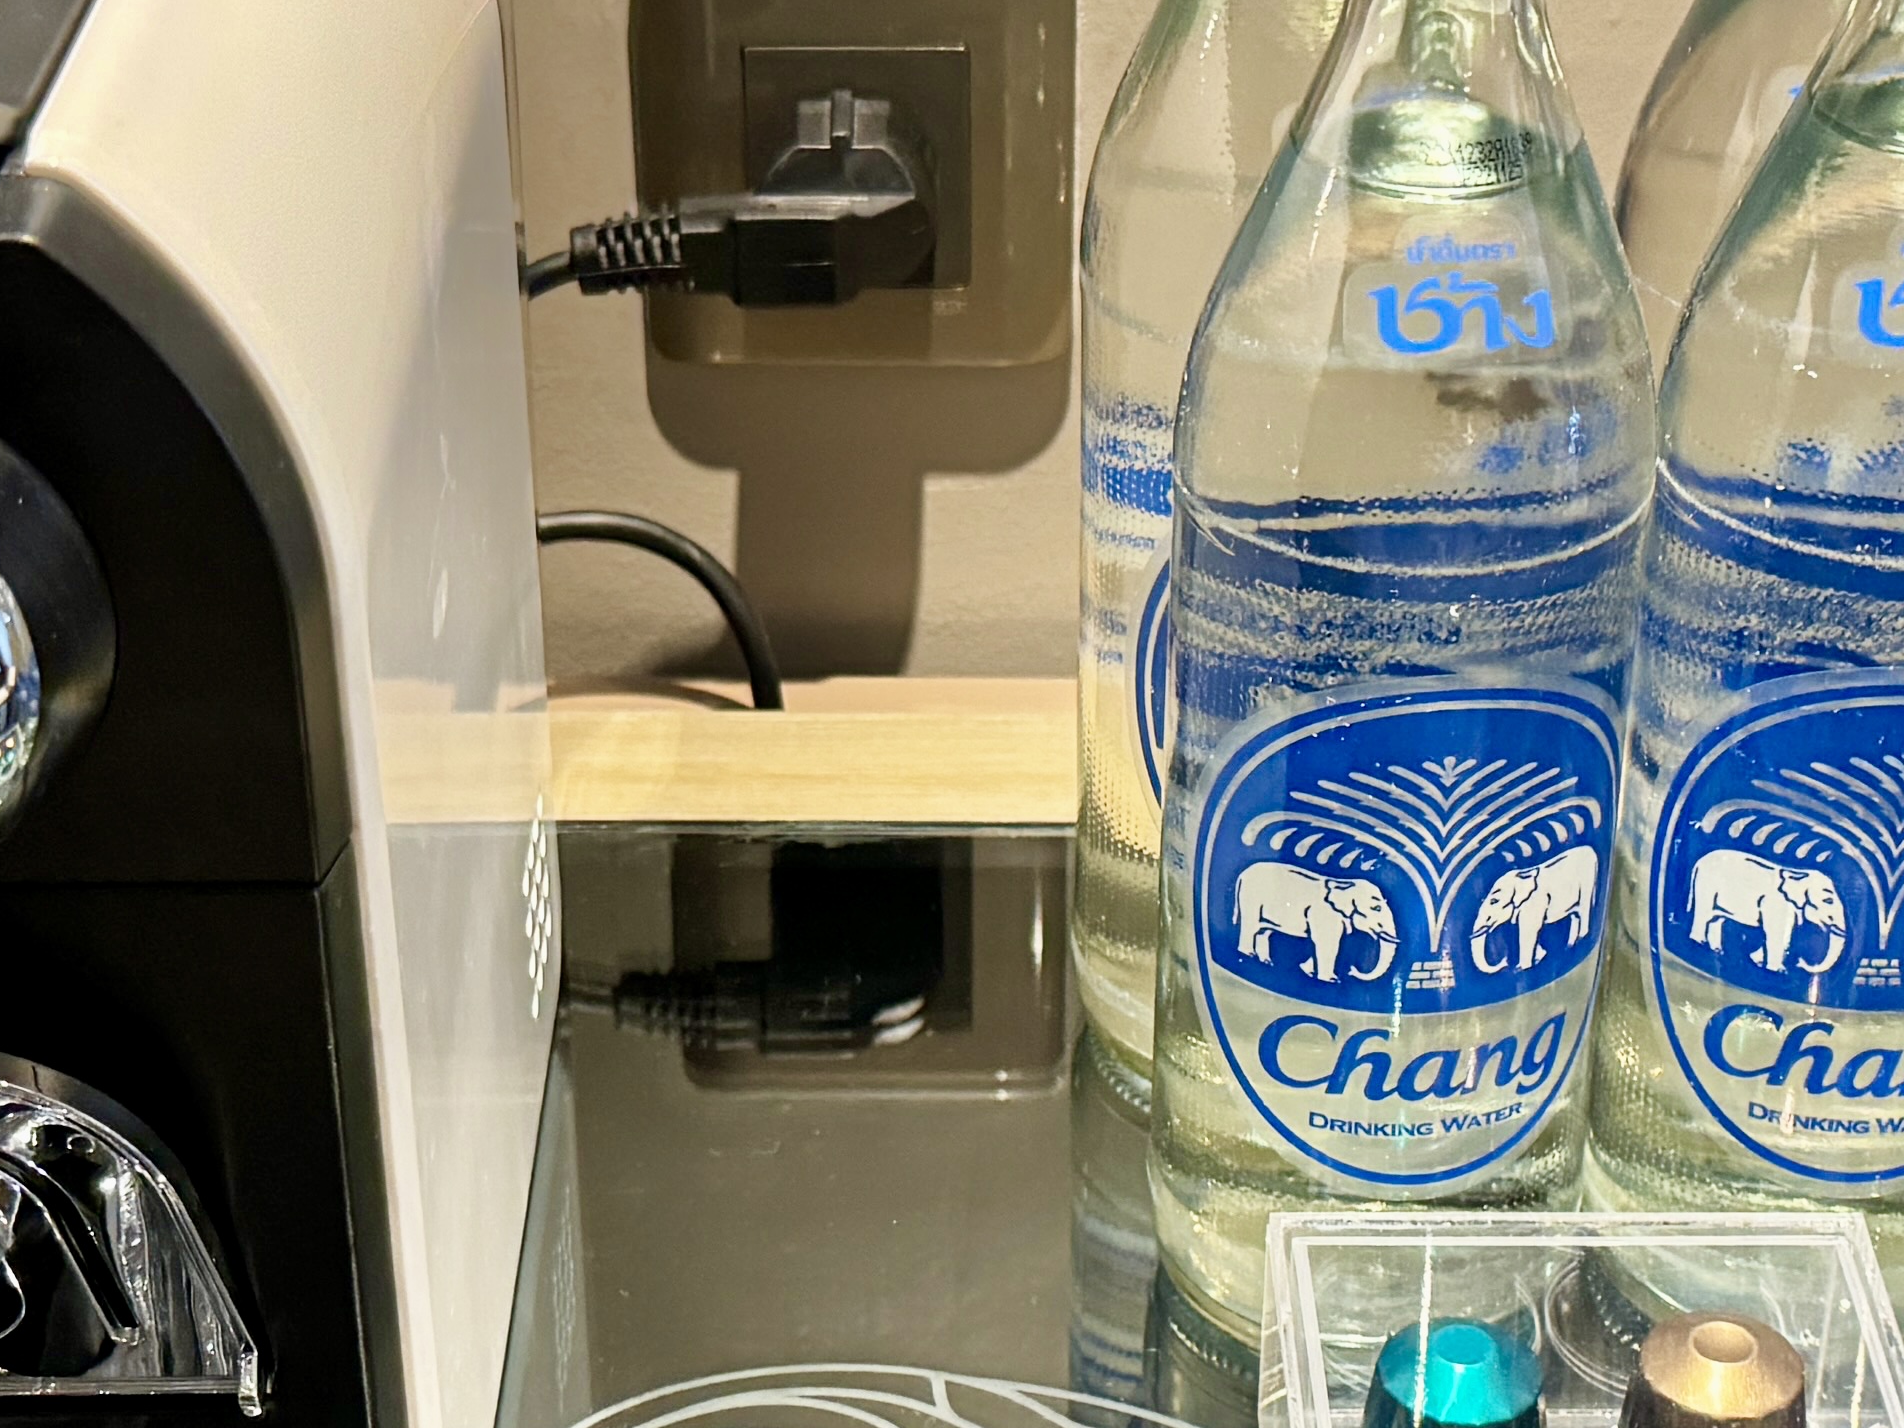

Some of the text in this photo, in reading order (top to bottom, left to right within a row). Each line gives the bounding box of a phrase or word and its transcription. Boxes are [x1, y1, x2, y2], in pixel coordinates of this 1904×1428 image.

[1368, 271, 1556, 355] ช้าง
[1258, 1011, 1567, 1102] Chang
[1308, 1102, 1523, 1137] DRINKING WATER
[1747, 1101, 1870, 1135] DRNKING
